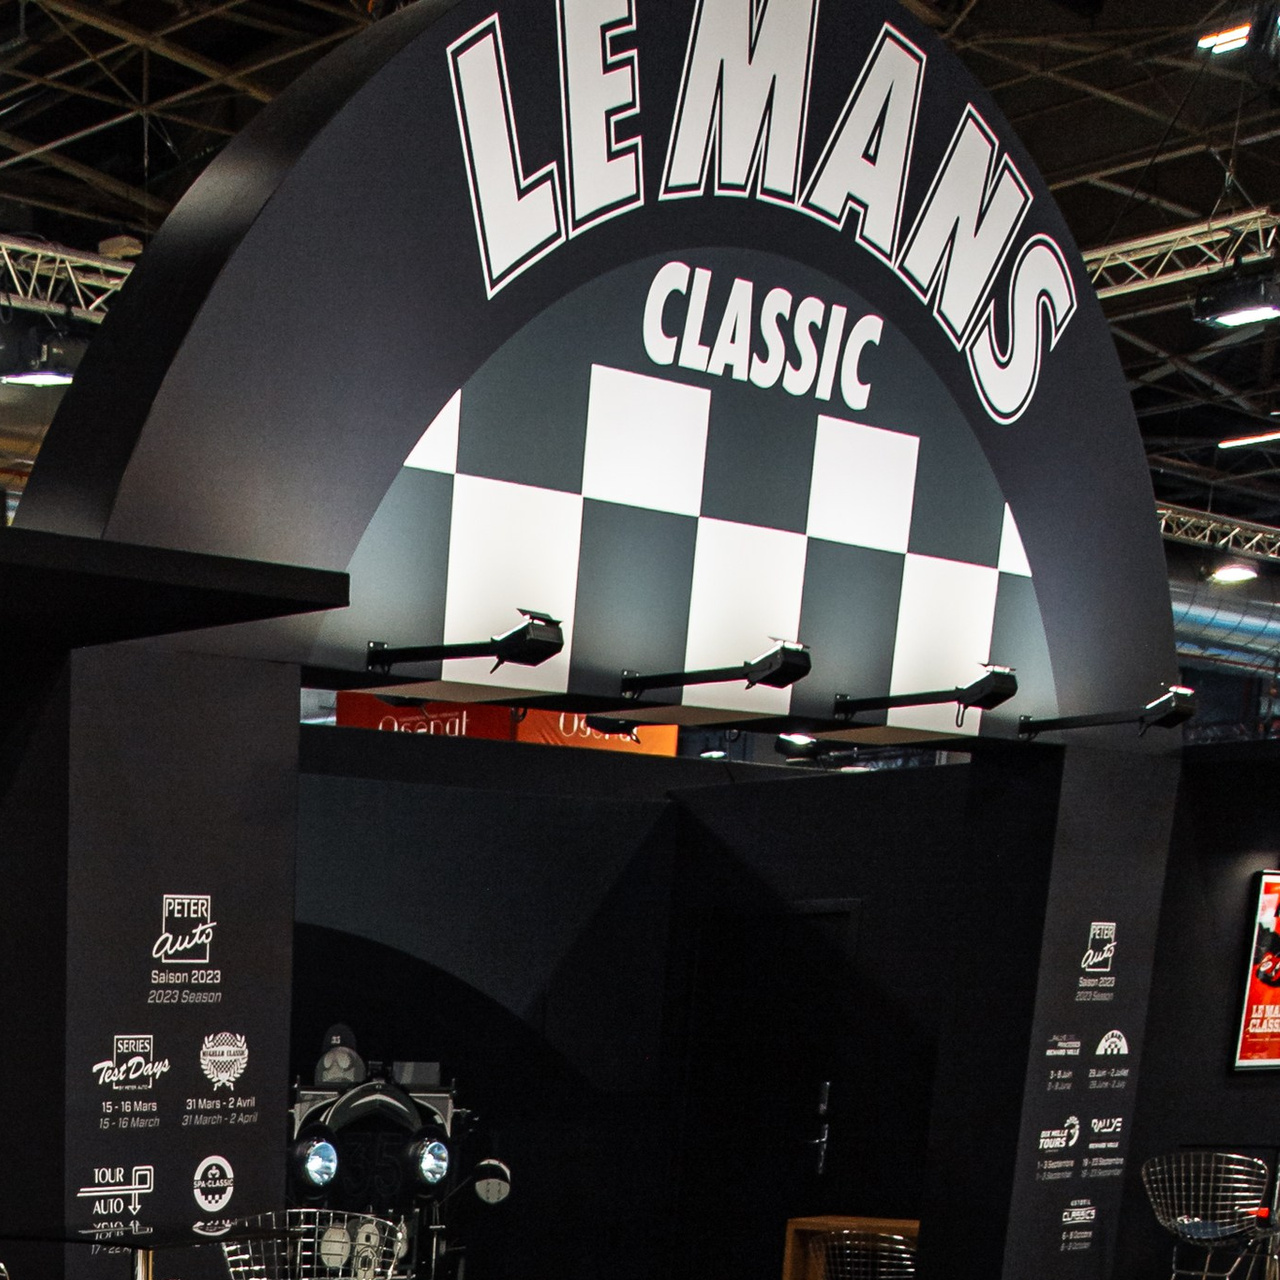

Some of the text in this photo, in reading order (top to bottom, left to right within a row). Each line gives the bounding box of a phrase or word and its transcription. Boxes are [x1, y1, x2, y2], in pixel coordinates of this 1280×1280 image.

[447, 0, 1077, 424] LE MANS
[642, 261, 884, 410] CLASSIC
[165, 899, 208, 918] PETER
[1092, 925, 1114, 939] PETER
[151, 969, 221, 984] Saison 2023
[147, 990, 222, 1003] 2023 Season
[1251, 1005, 1264, 1018] LE
[117, 1039, 150, 1053] SERIES
[92, 1056, 170, 1085] Test Days
[102, 1101, 112, 1113] 15
[121, 1101, 131, 1112] 16
[133, 1101, 157, 1112] Mars
[186, 1098, 196, 1110] 31
[198, 1098, 220, 1109] Mars
[228, 1097, 234, 1108] 2
[236, 1096, 255, 1108] Avril
[99, 1118, 110, 1129] 15
[118, 1117, 128, 1129] 16
[130, 1116, 160, 1128] March
[181, 1114, 192, 1126] 31
[194, 1113, 222, 1125] March
[229, 1113, 236, 1124] 2
[238, 1111, 258, 1125] April
[1039, 1137, 1067, 1149] TOURS
[93, 1167, 124, 1184] TOUR
[93, 1198, 124, 1215] AUTO
